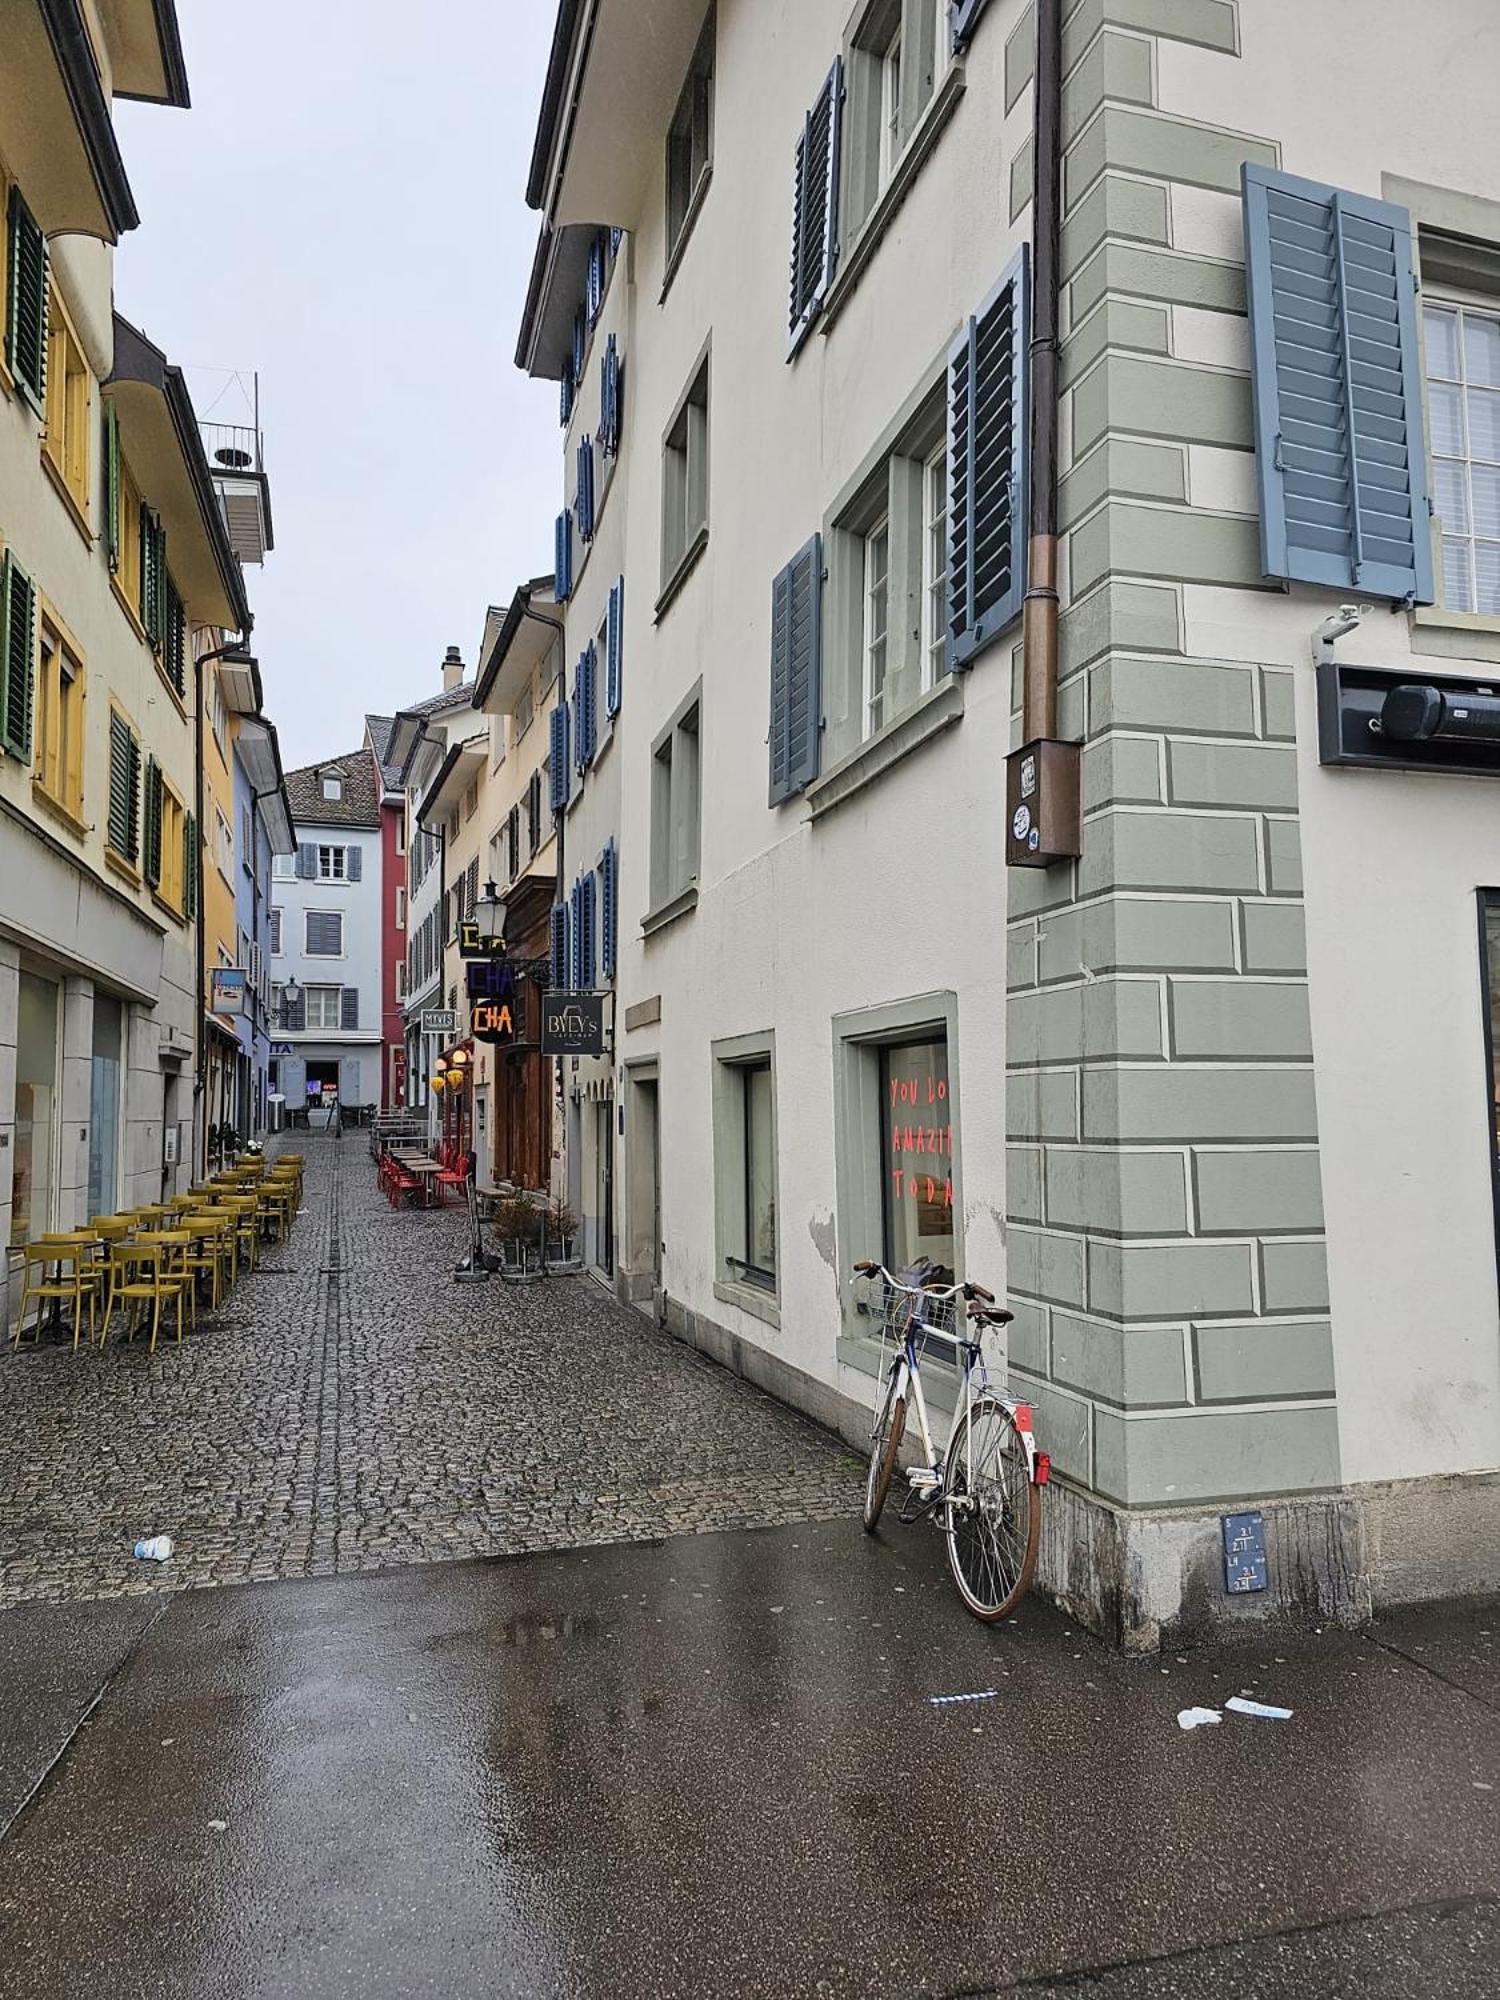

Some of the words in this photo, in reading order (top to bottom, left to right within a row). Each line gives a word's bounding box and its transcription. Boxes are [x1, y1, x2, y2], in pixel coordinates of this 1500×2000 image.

[471, 963, 514, 994] CHA
[474, 1005, 513, 1034] CHA
[890, 1077, 918, 1108] YOU
